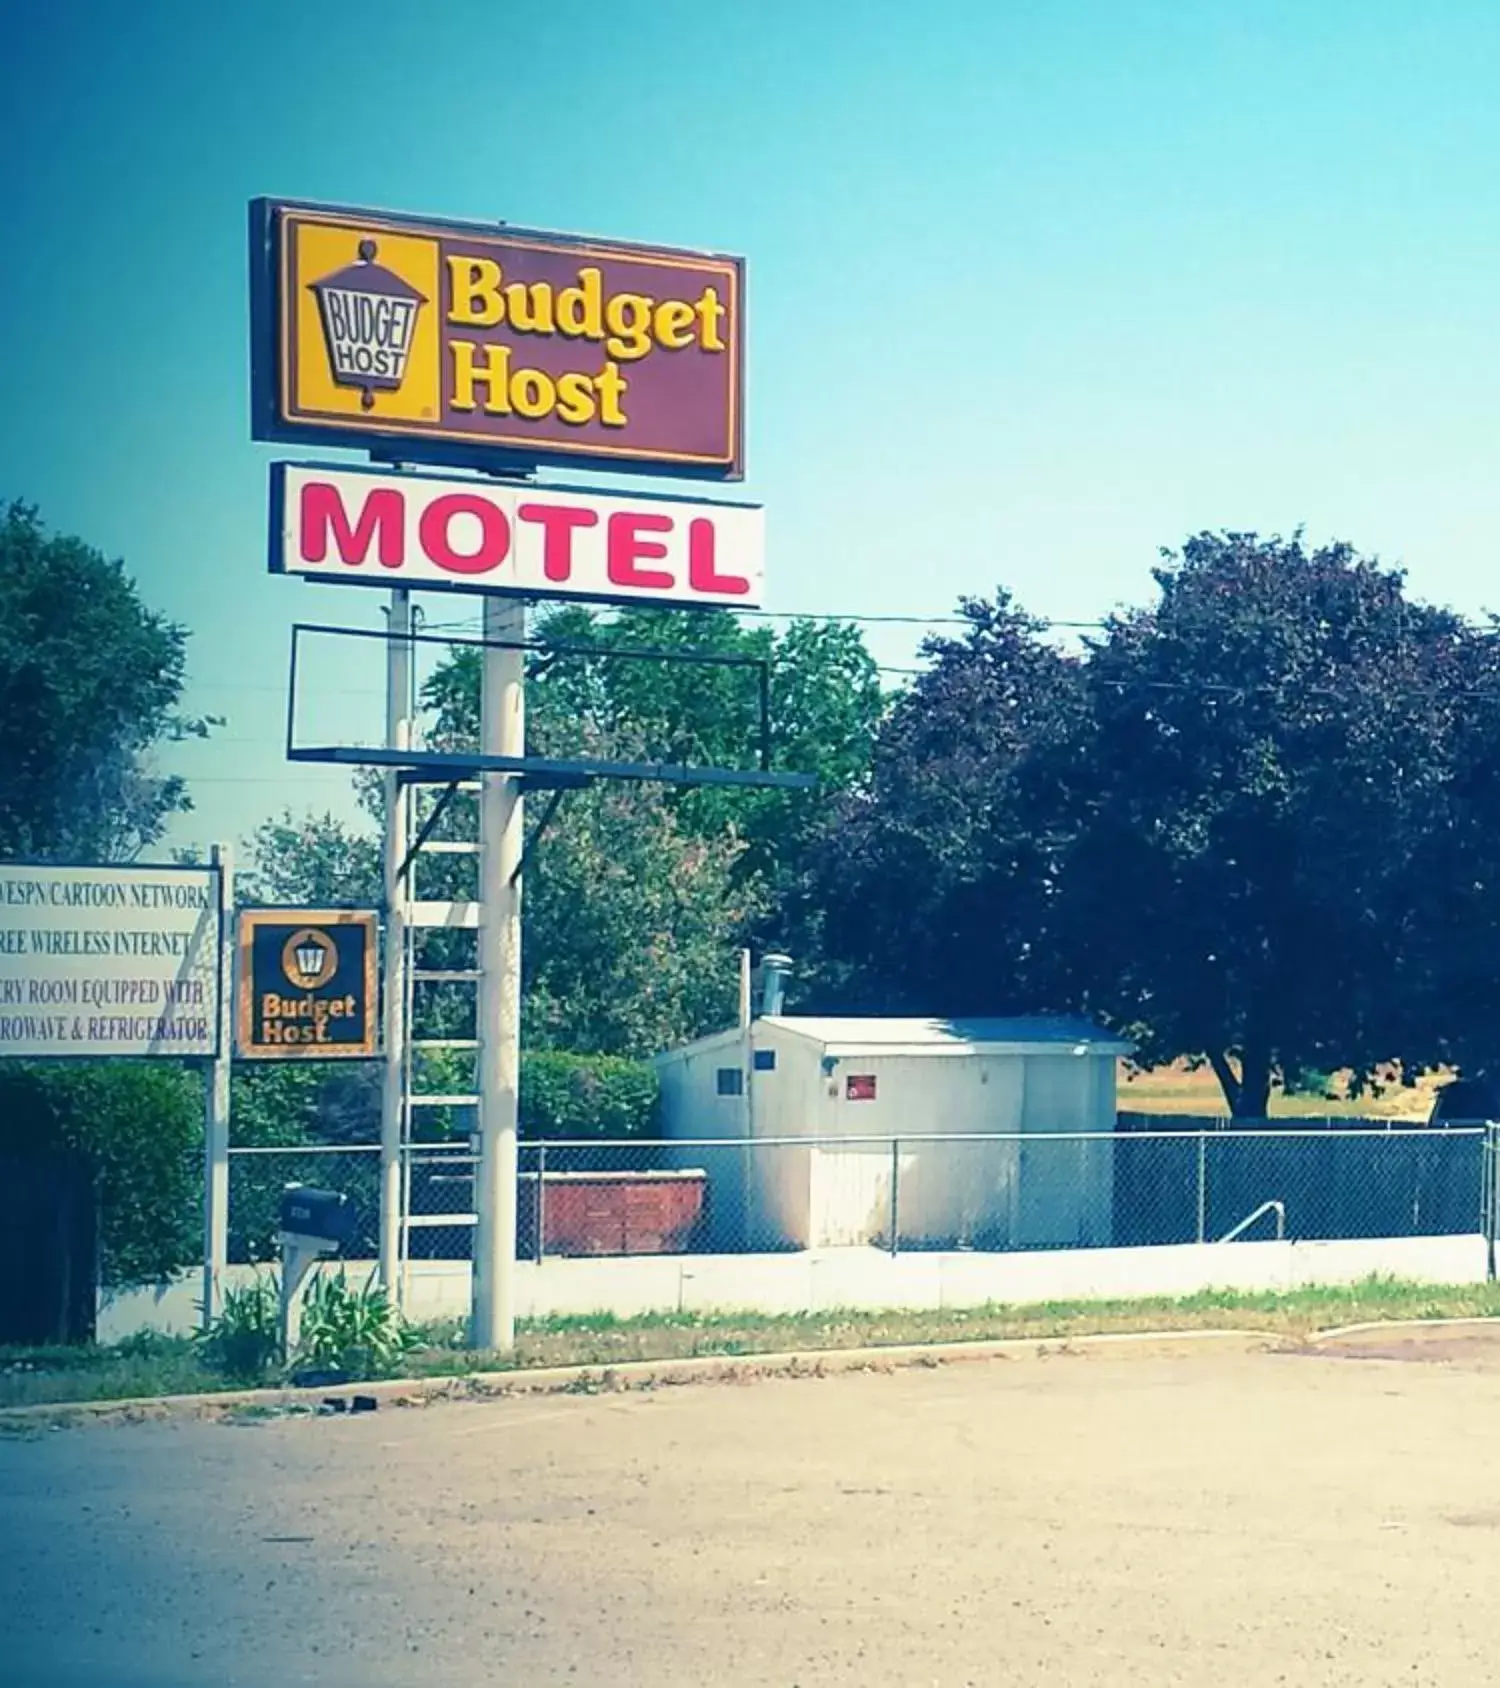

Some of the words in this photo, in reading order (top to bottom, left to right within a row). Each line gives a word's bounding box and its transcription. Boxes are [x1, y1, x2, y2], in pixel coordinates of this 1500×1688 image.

[327, 290, 415, 350] BUDGET
[447, 254, 725, 360] Budget
[336, 343, 405, 376] HOST
[449, 341, 628, 427] Host
[300, 482, 750, 595] MOTEL
[51, 881, 126, 908] CARTOON
[131, 883, 209, 910] NETWORK
[31, 930, 111, 955] WIRELESS
[114, 931, 191, 957] INTERNET
[29, 979, 77, 1005] ROOM
[81, 979, 160, 1009] EQUIPPED
[163, 979, 204, 1005] WITH
[262, 992, 356, 1024] Budget
[71, 1015, 83, 1041] &
[88, 1015, 207, 1041] REFRIGERATOR
